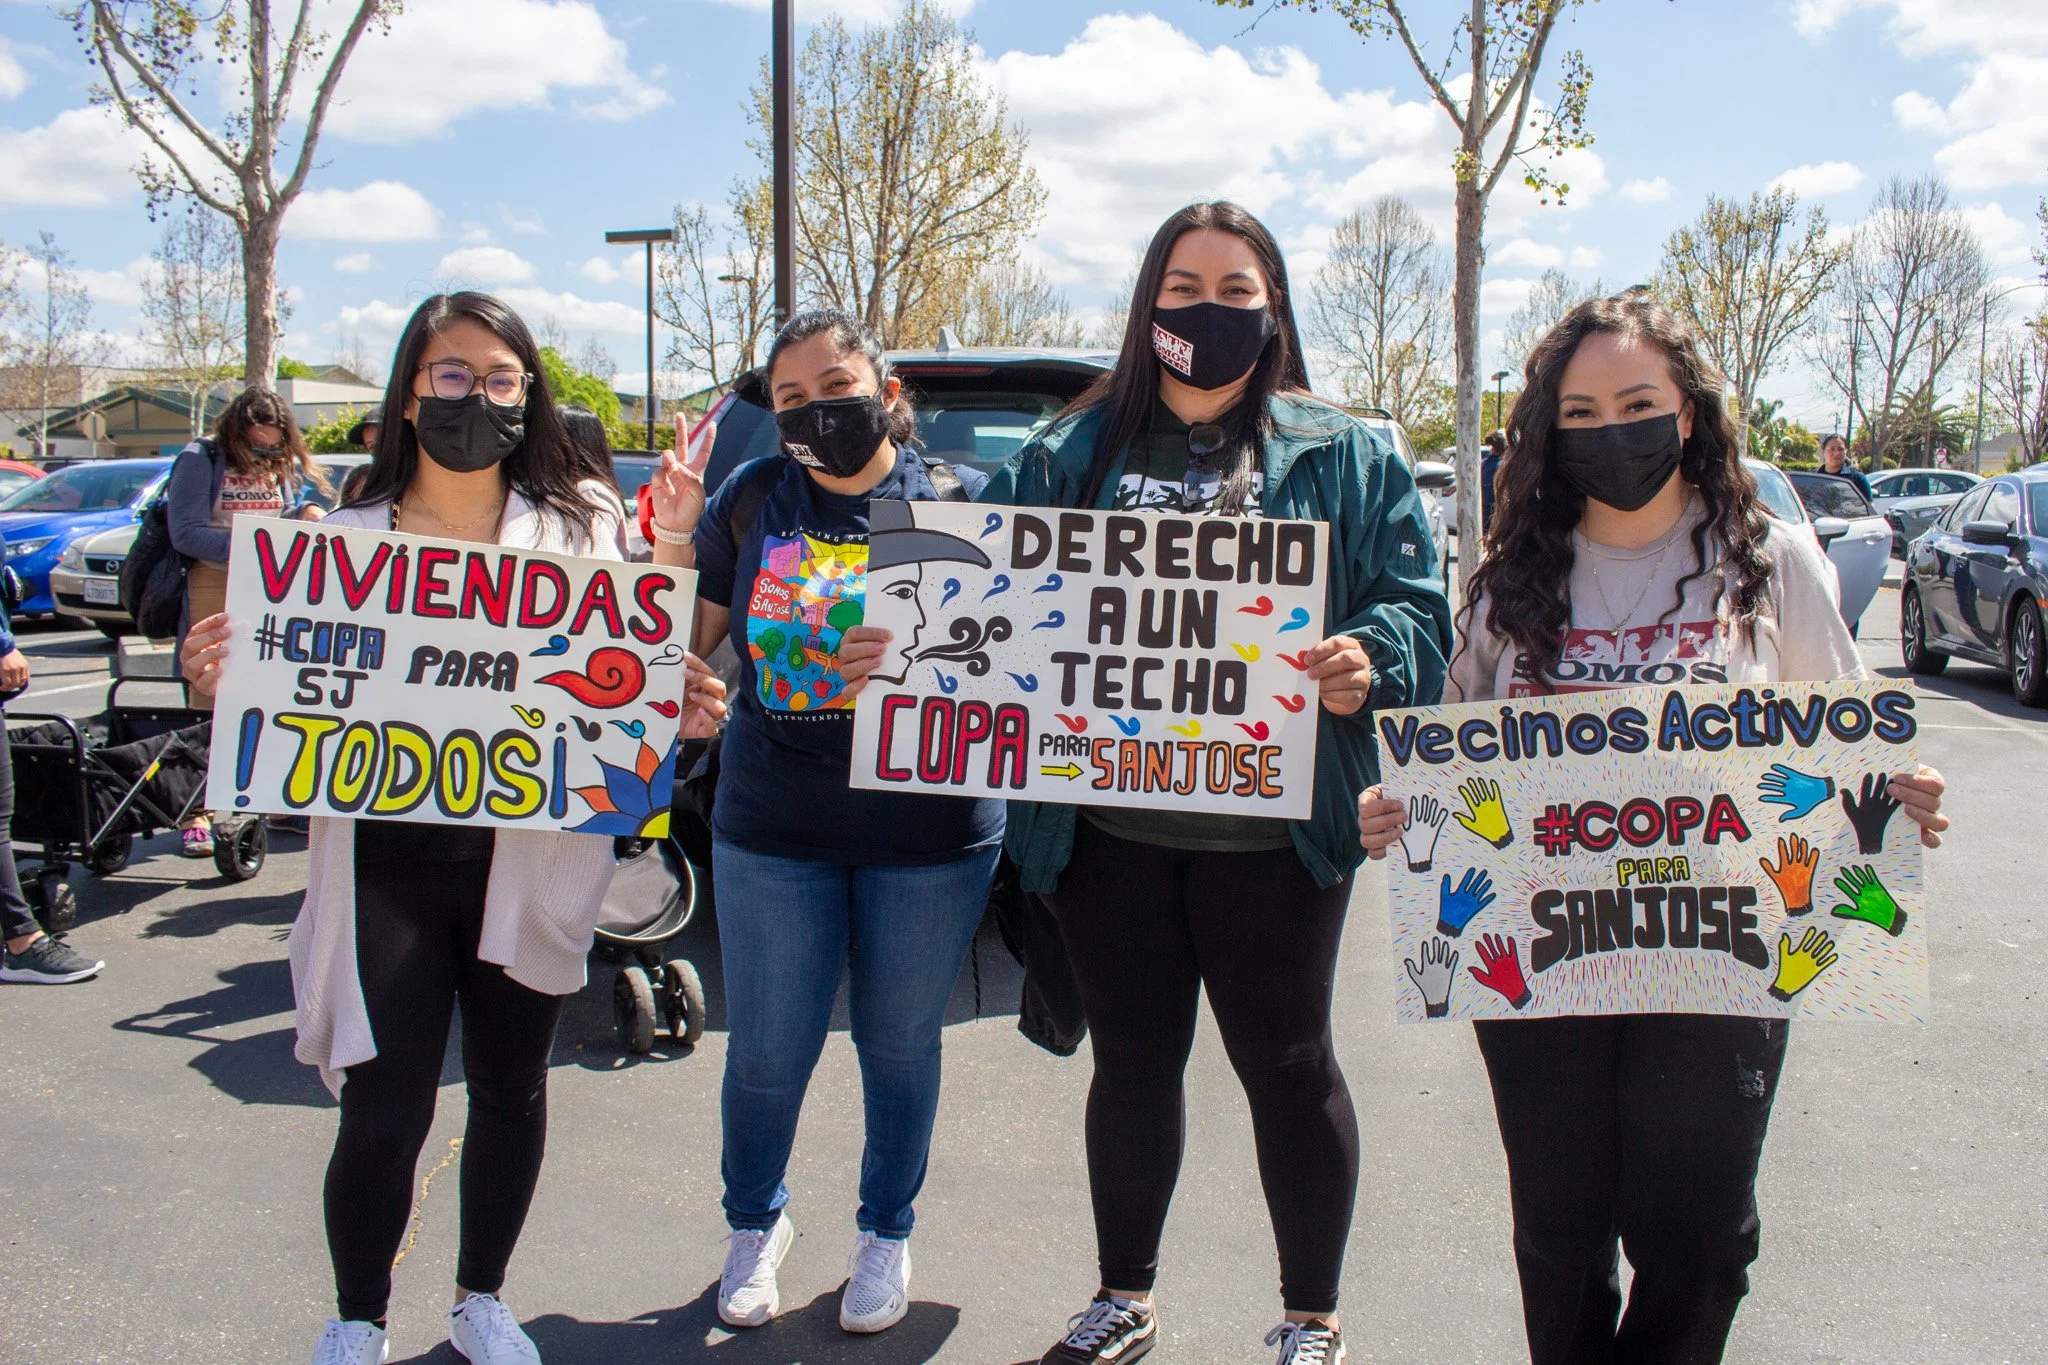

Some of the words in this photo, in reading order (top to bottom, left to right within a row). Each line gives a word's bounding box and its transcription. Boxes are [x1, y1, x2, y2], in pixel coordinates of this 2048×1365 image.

[1153, 342, 1189, 367] OMOS
[221, 490, 280, 501] SOMOS
[781, 525, 839, 542] BUILING
[1011, 513, 1316, 586] DERECHO
[254, 613, 386, 670] #COPA
[405, 645, 520, 692] PARA
[293, 667, 370, 708] SJ
[1050, 651, 1248, 715] TECHO
[765, 709, 840, 722] CNSTRUYENDO
[876, 693, 1030, 790] COPA
[1038, 733, 1091, 757] PARA
[1381, 703, 1649, 766] Vecinos
[1657, 689, 1917, 752] Activos
[1533, 793, 1752, 857] #COPA
[1616, 856, 1690, 887] PARA
